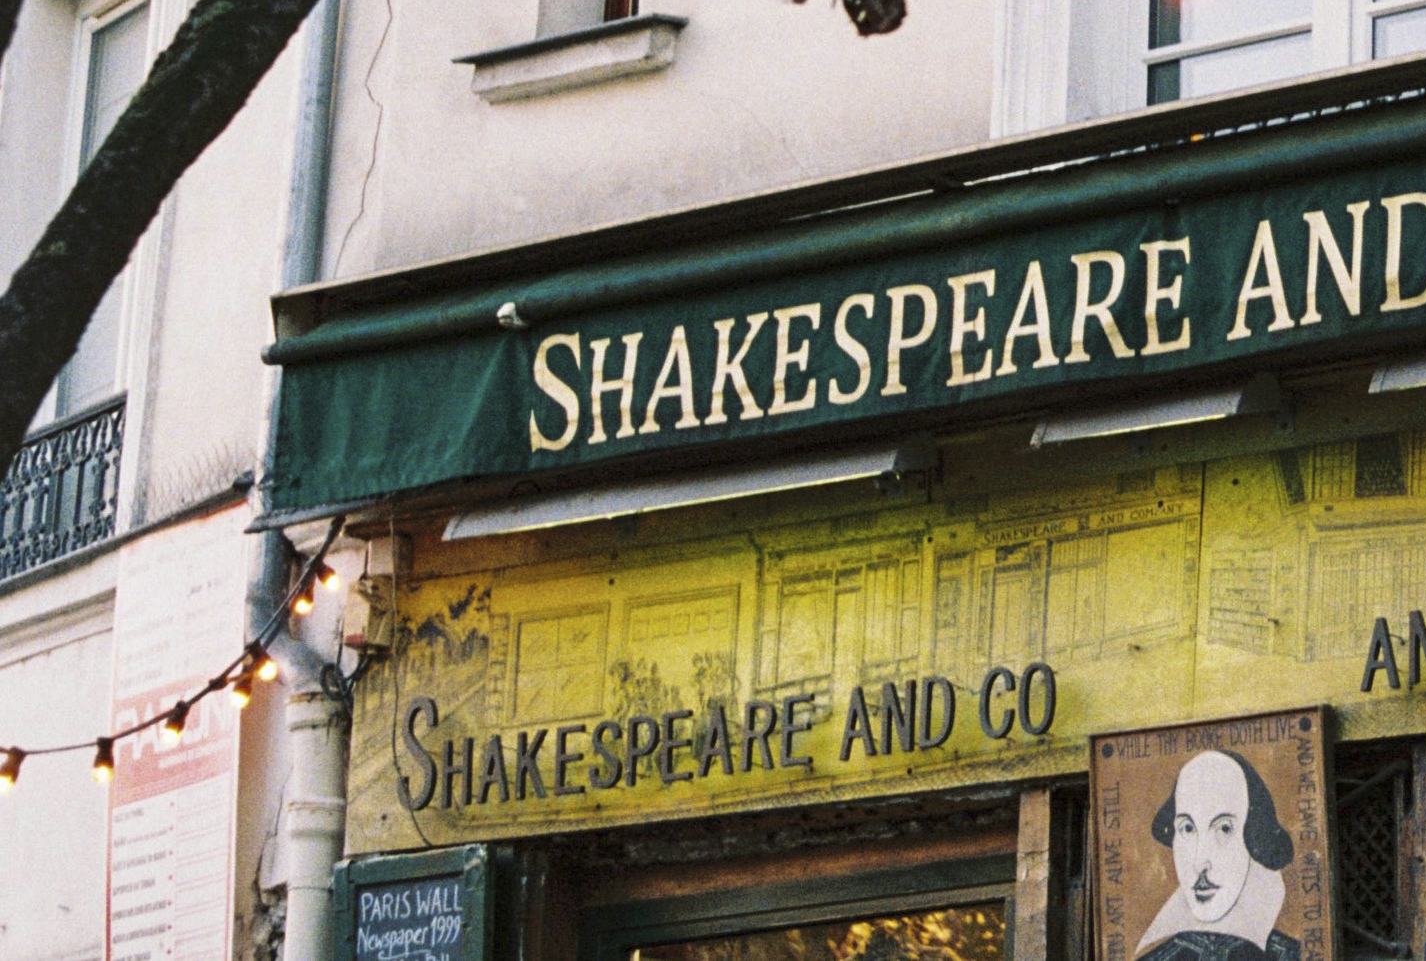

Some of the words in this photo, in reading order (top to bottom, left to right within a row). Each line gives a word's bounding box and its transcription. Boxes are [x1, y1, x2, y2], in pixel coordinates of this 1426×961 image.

[529, 236, 1192, 453] SHAKESPEARE
[1099, 511, 1125, 528] AND
[402, 693, 814, 812] SHAKESPEARE
[838, 674, 957, 762] AND
[978, 661, 1057, 740] CO
[1267, 716, 1299, 744] LIVE
[1296, 736, 1315, 767] AND
[1102, 781, 1122, 830] STILL
[1299, 798, 1319, 841] HAVE
[1104, 838, 1123, 886] ALIVE
[360, 890, 412, 923] PARIS
[416, 884, 464, 916] WALL
[1105, 895, 1124, 927] ART
[356, 924, 429, 958] Newspaper
[430, 914, 462, 948] 1999
[1303, 927, 1324, 961] REA
